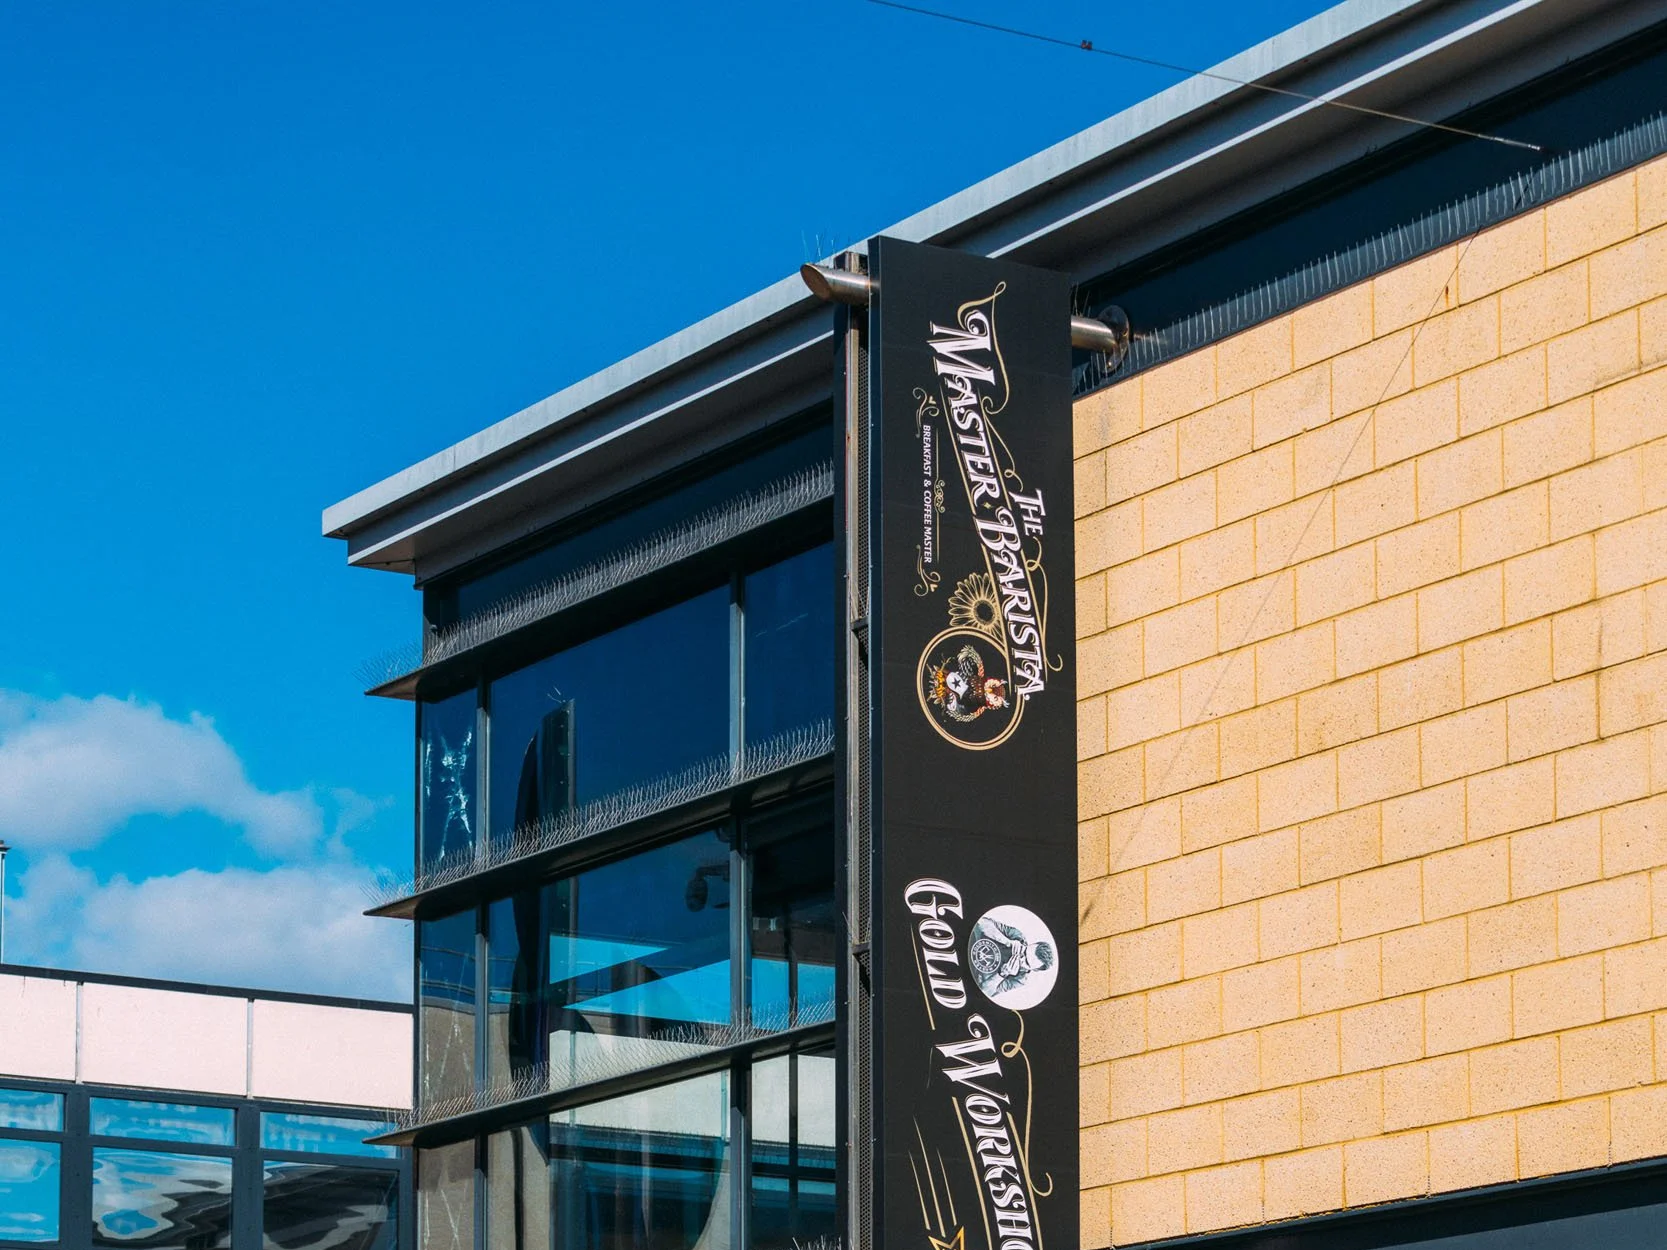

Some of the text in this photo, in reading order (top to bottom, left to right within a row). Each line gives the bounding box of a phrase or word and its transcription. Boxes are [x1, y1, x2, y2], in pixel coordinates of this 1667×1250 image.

[923, 424, 932, 563] BREAKFAST & COFFEE MASTER
[926, 309, 1044, 700] MASTER BARISTA
[1009, 488, 1046, 536] THE
[903, 877, 967, 1010] GOLD
